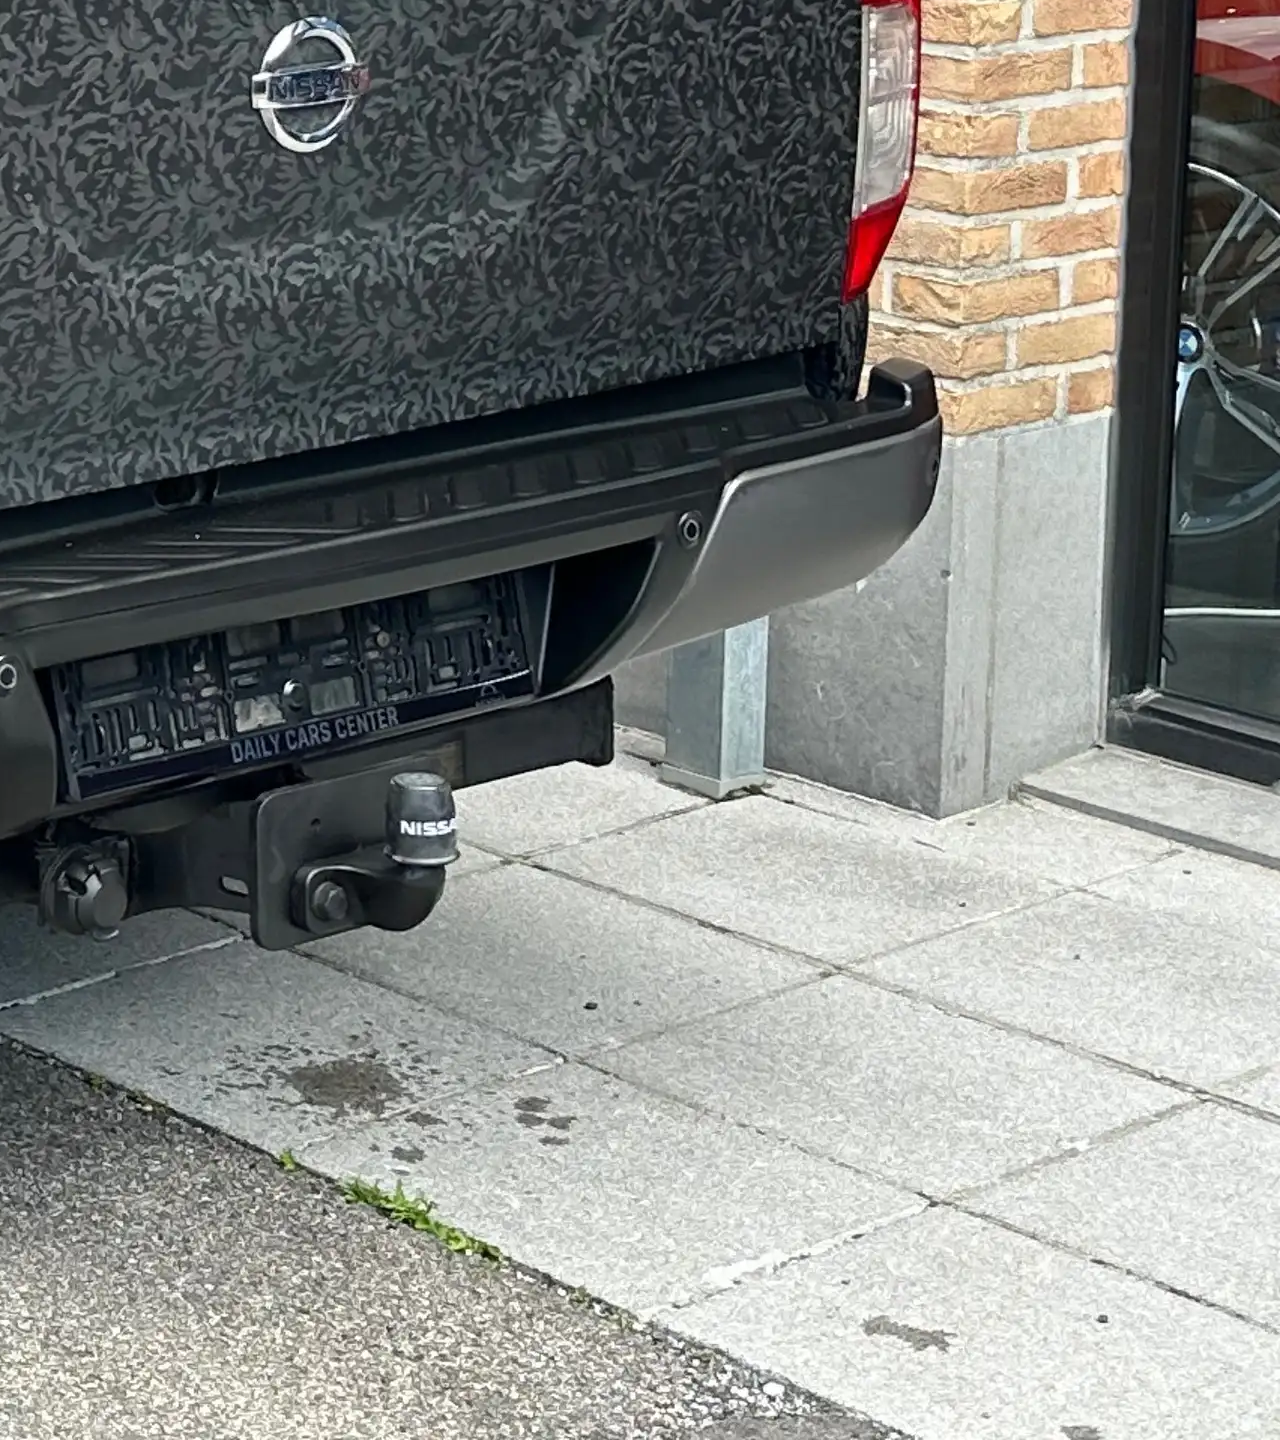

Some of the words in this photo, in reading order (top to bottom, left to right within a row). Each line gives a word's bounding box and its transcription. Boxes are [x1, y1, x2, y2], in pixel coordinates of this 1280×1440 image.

[269, 68, 363, 101] NISSAN
[229, 733, 281, 763] DAILY
[285, 721, 332, 751] CARS
[336, 707, 399, 739] CENTER
[400, 819, 457, 837] NISSA
